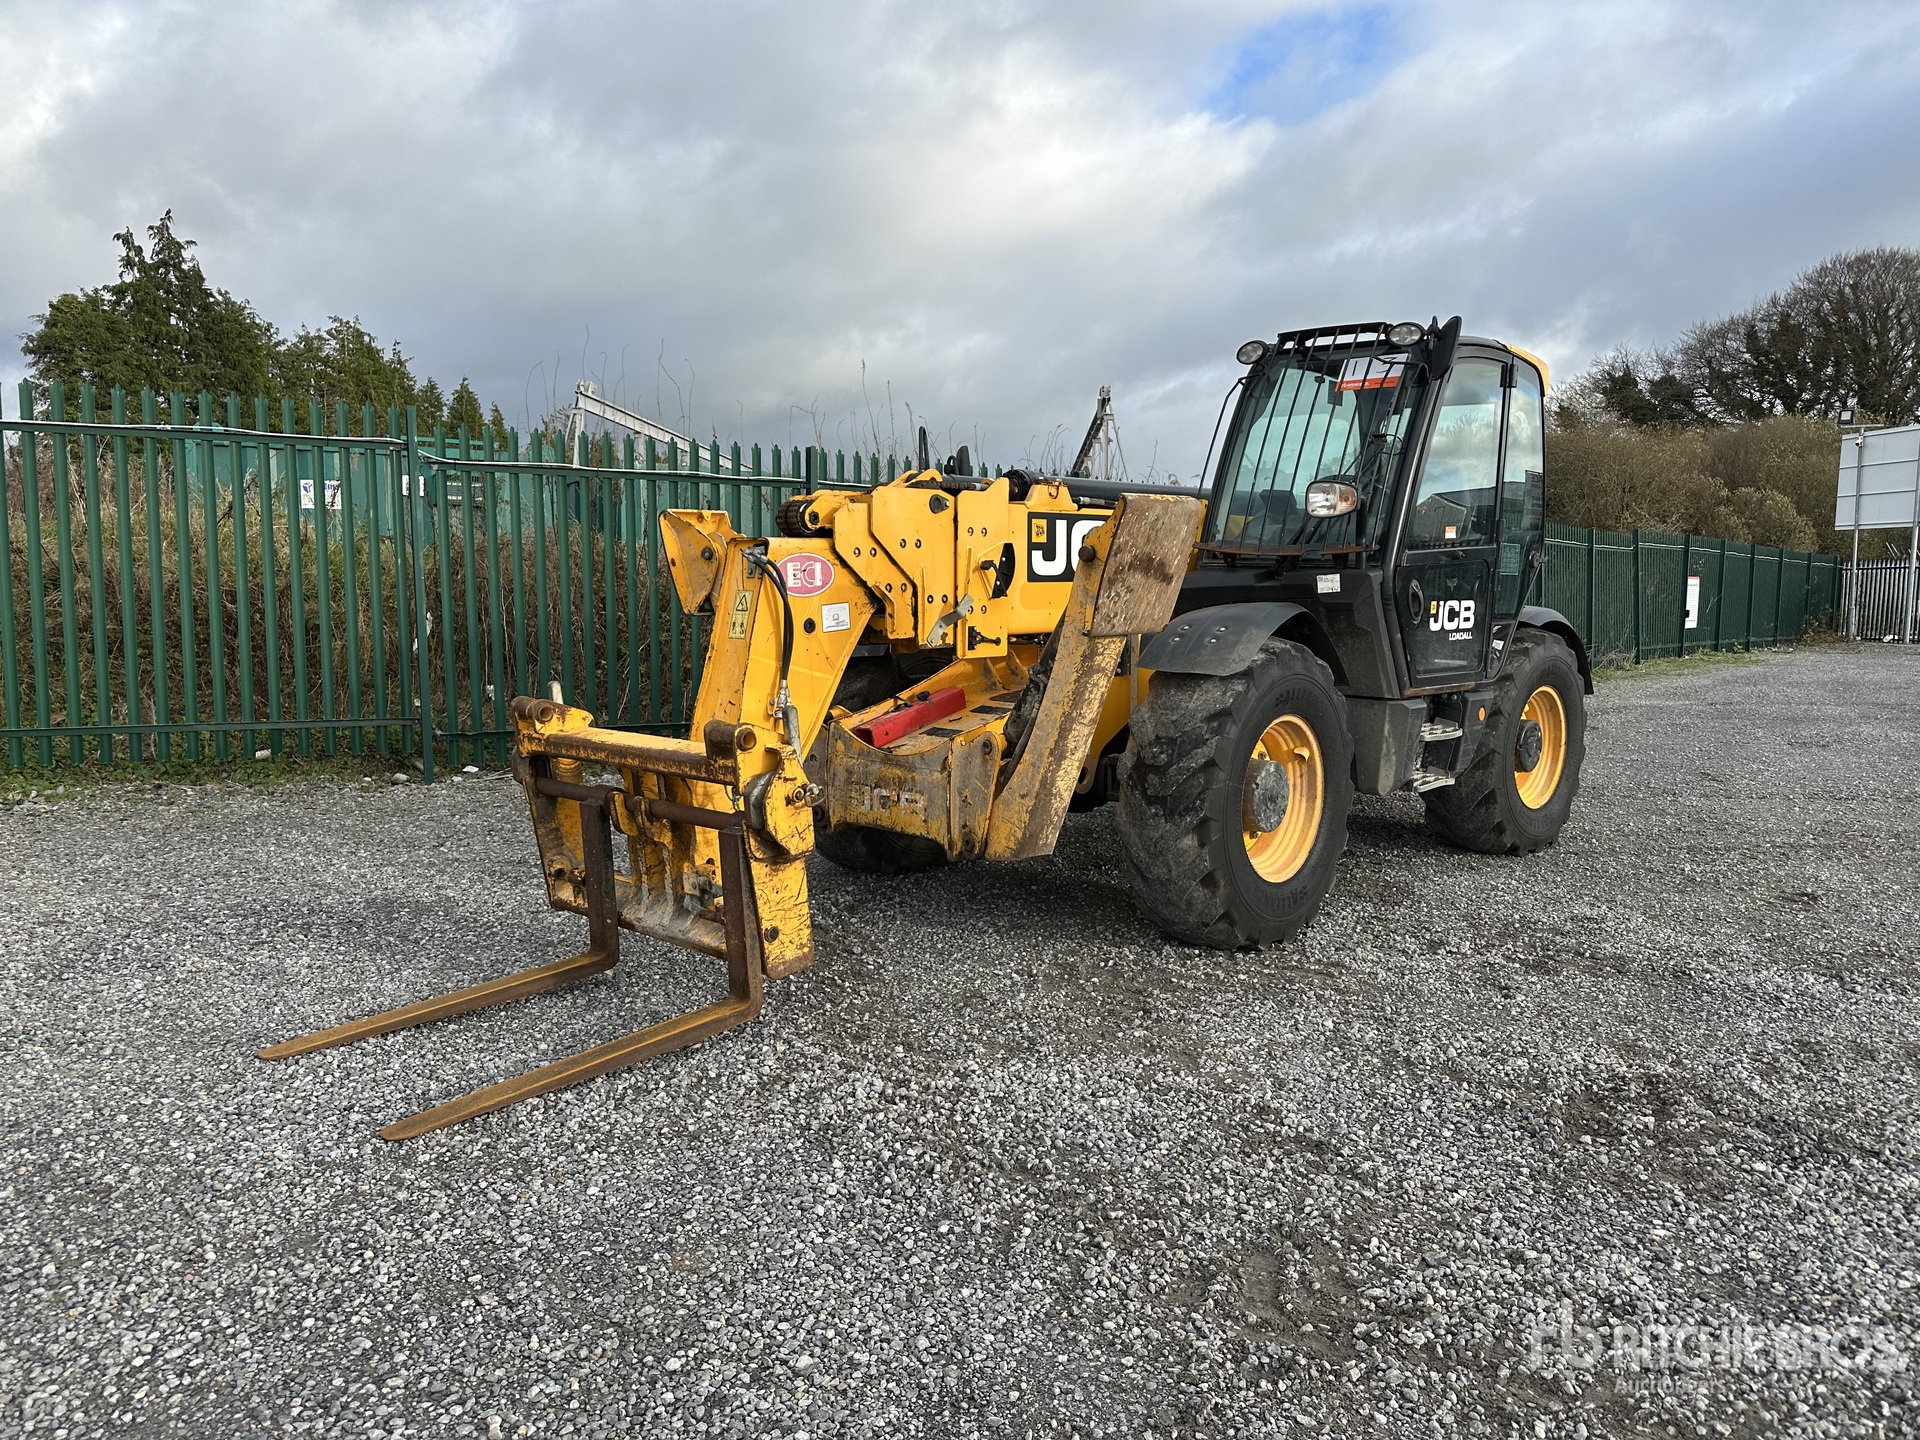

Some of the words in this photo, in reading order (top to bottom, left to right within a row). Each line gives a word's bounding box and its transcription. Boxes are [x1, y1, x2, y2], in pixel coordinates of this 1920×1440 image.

[1031, 519, 1106, 576] JC
[1429, 600, 1475, 631] JCB
[1448, 631, 1473, 641] LOADALL
